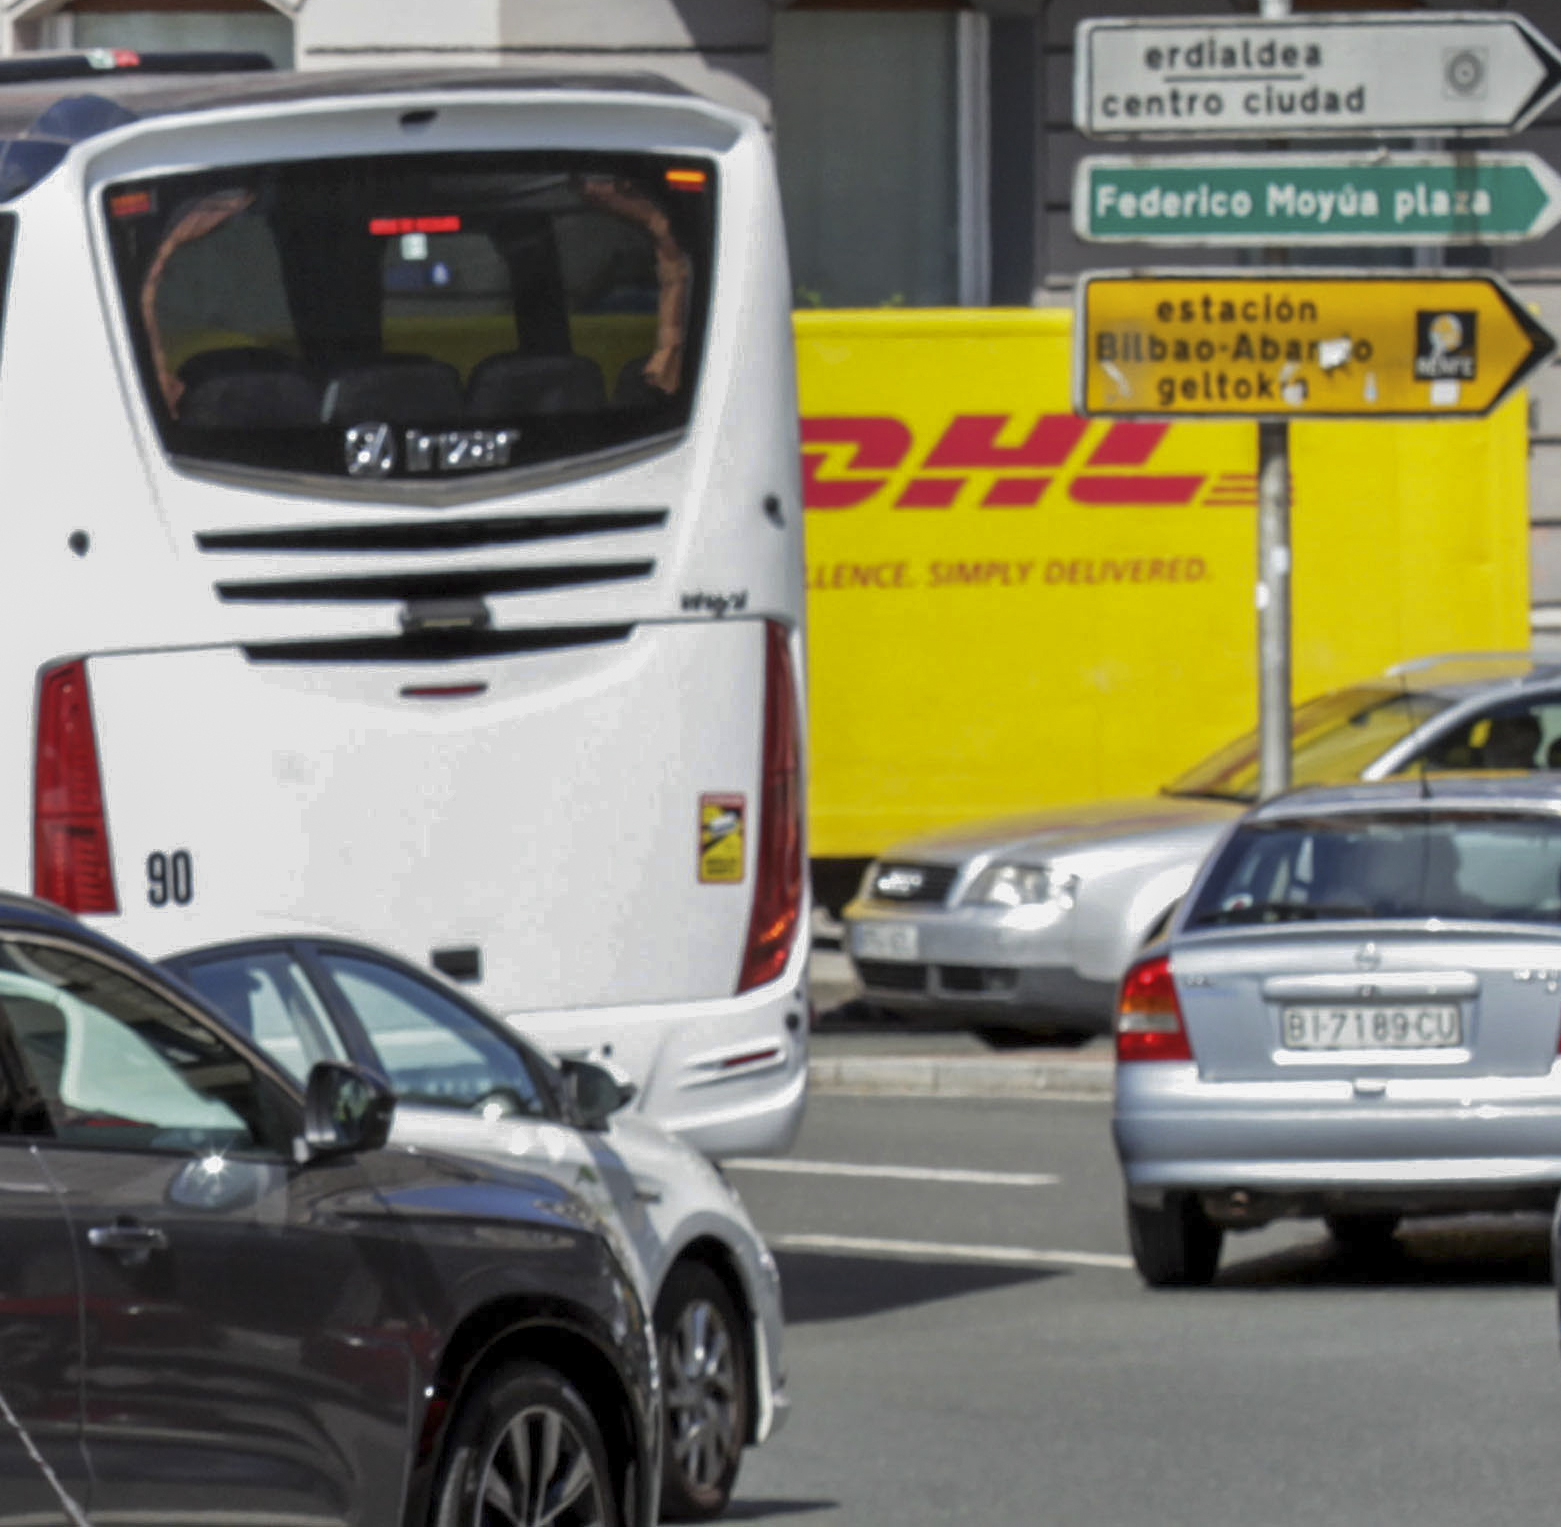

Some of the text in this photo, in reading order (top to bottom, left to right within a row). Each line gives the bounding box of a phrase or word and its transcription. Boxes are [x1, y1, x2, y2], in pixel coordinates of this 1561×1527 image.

[1144, 36, 1322, 70] erdialdea
[1101, 83, 1367, 119] centro ciudad
[1095, 181, 1492, 224] Federico Moyúa plaza
[1156, 294, 1317, 323] estación
[926, 558, 1033, 588] SIMPLY
[146, 849, 194, 907] 90
